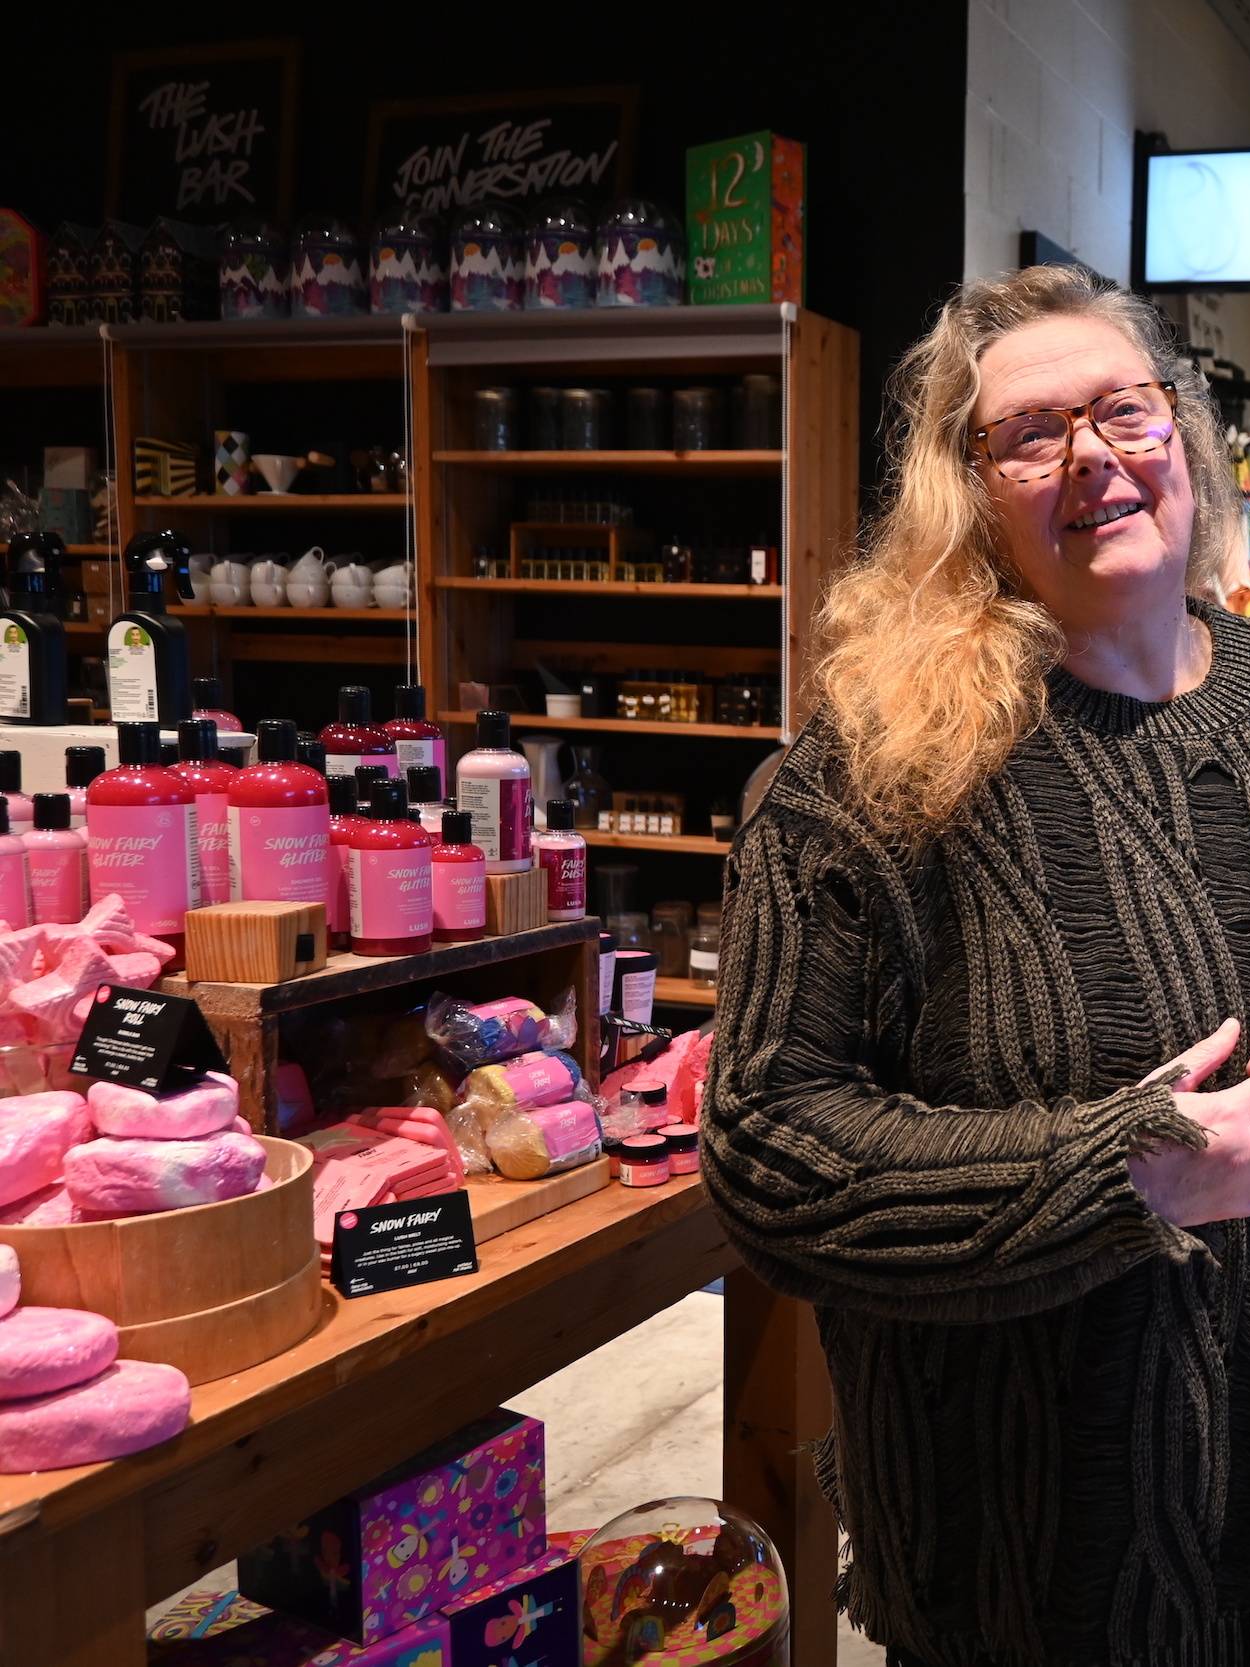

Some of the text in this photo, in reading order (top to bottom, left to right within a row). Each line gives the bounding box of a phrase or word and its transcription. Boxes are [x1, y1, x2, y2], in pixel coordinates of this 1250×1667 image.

[138, 80, 211, 129] THE
[175, 109, 266, 164] LUSH
[392, 118, 553, 199] JOIN THE
[176, 158, 256, 211] BAR
[709, 151, 750, 211] 12
[702, 218, 753, 252] DAYS
[115, 834, 163, 850] FAIRY
[263, 836, 306, 851] SNOW
[92, 852, 145, 868] GLITTER
[279, 848, 327, 868] GLITTER
[387, 867, 418, 879] SNOW
[409, 922, 429, 932] LUSH
[113, 997, 168, 1017] SNOW FAIRY
[369, 1216, 406, 1235] SNOW
[406, 1207, 443, 1228] FAIRY
